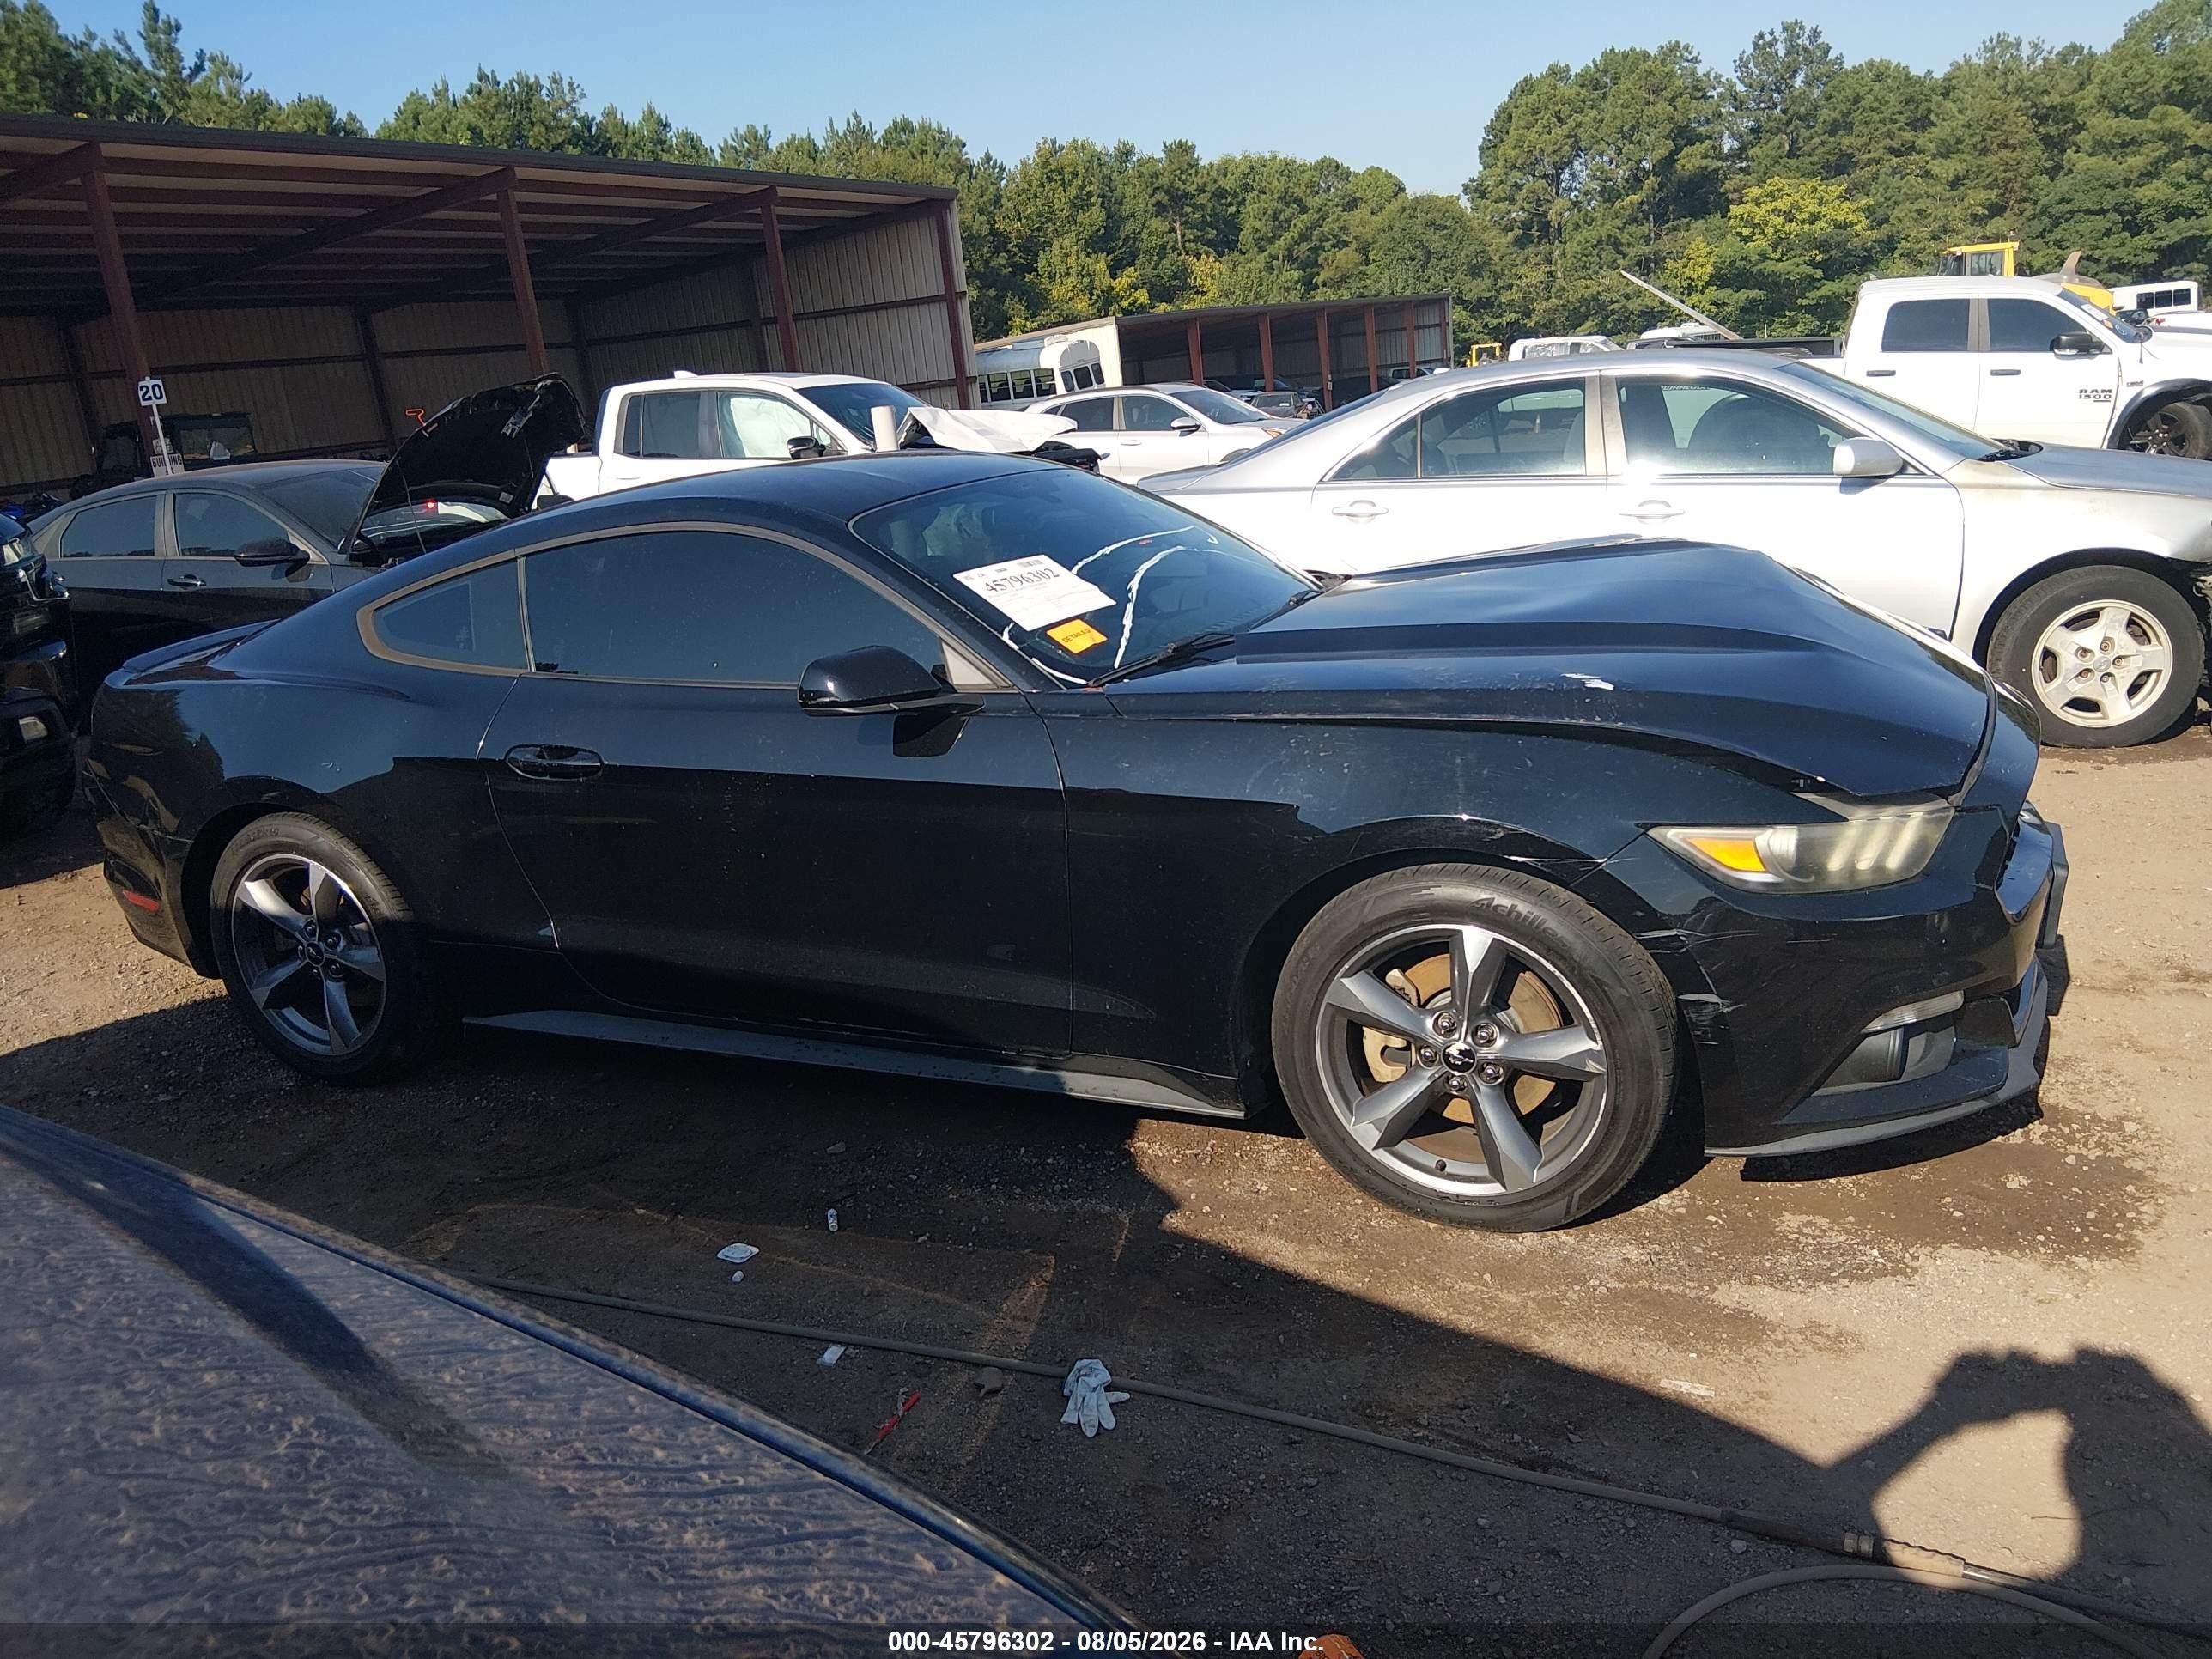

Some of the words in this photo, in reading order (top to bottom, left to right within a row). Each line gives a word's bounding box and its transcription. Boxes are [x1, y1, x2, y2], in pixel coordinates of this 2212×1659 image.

[139, 384, 163, 401] 20
[152, 455, 182, 468] BUIING
[985, 568, 1060, 592] 45796302
[1469, 896, 1569, 948] Achilles
